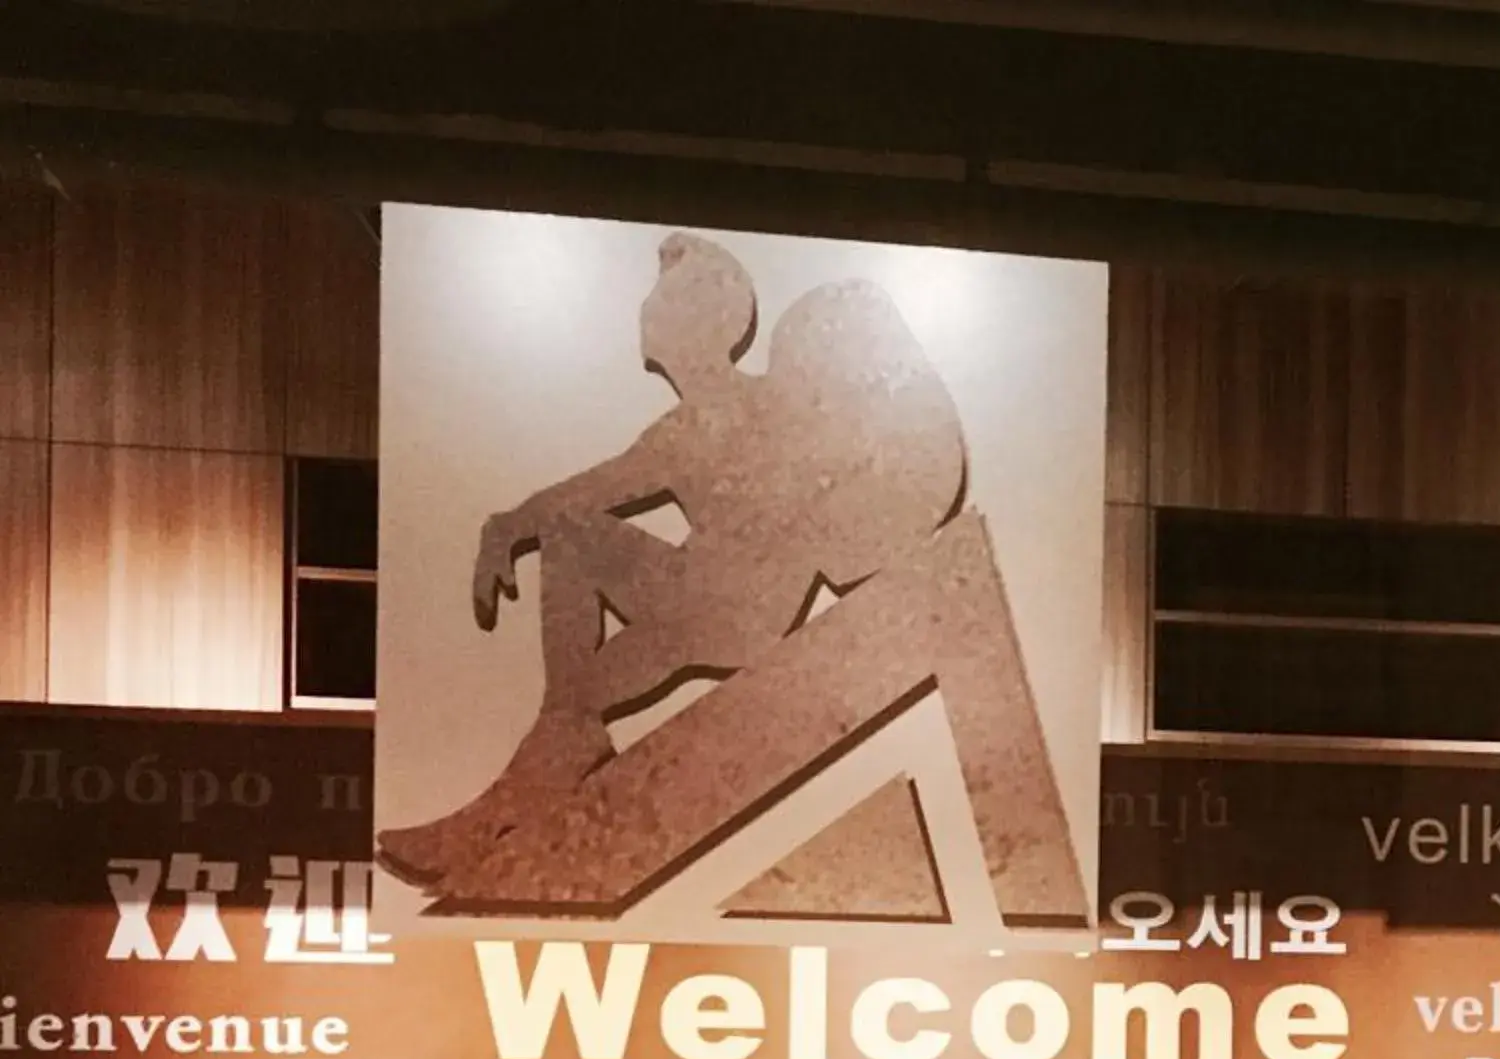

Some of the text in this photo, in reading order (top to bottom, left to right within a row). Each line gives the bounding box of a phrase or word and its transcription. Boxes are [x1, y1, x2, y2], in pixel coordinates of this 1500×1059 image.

[14, 748, 273, 823] Добро
[105, 853, 395, 962] 欢迎
[1101, 890, 1347, 960] 오세요
